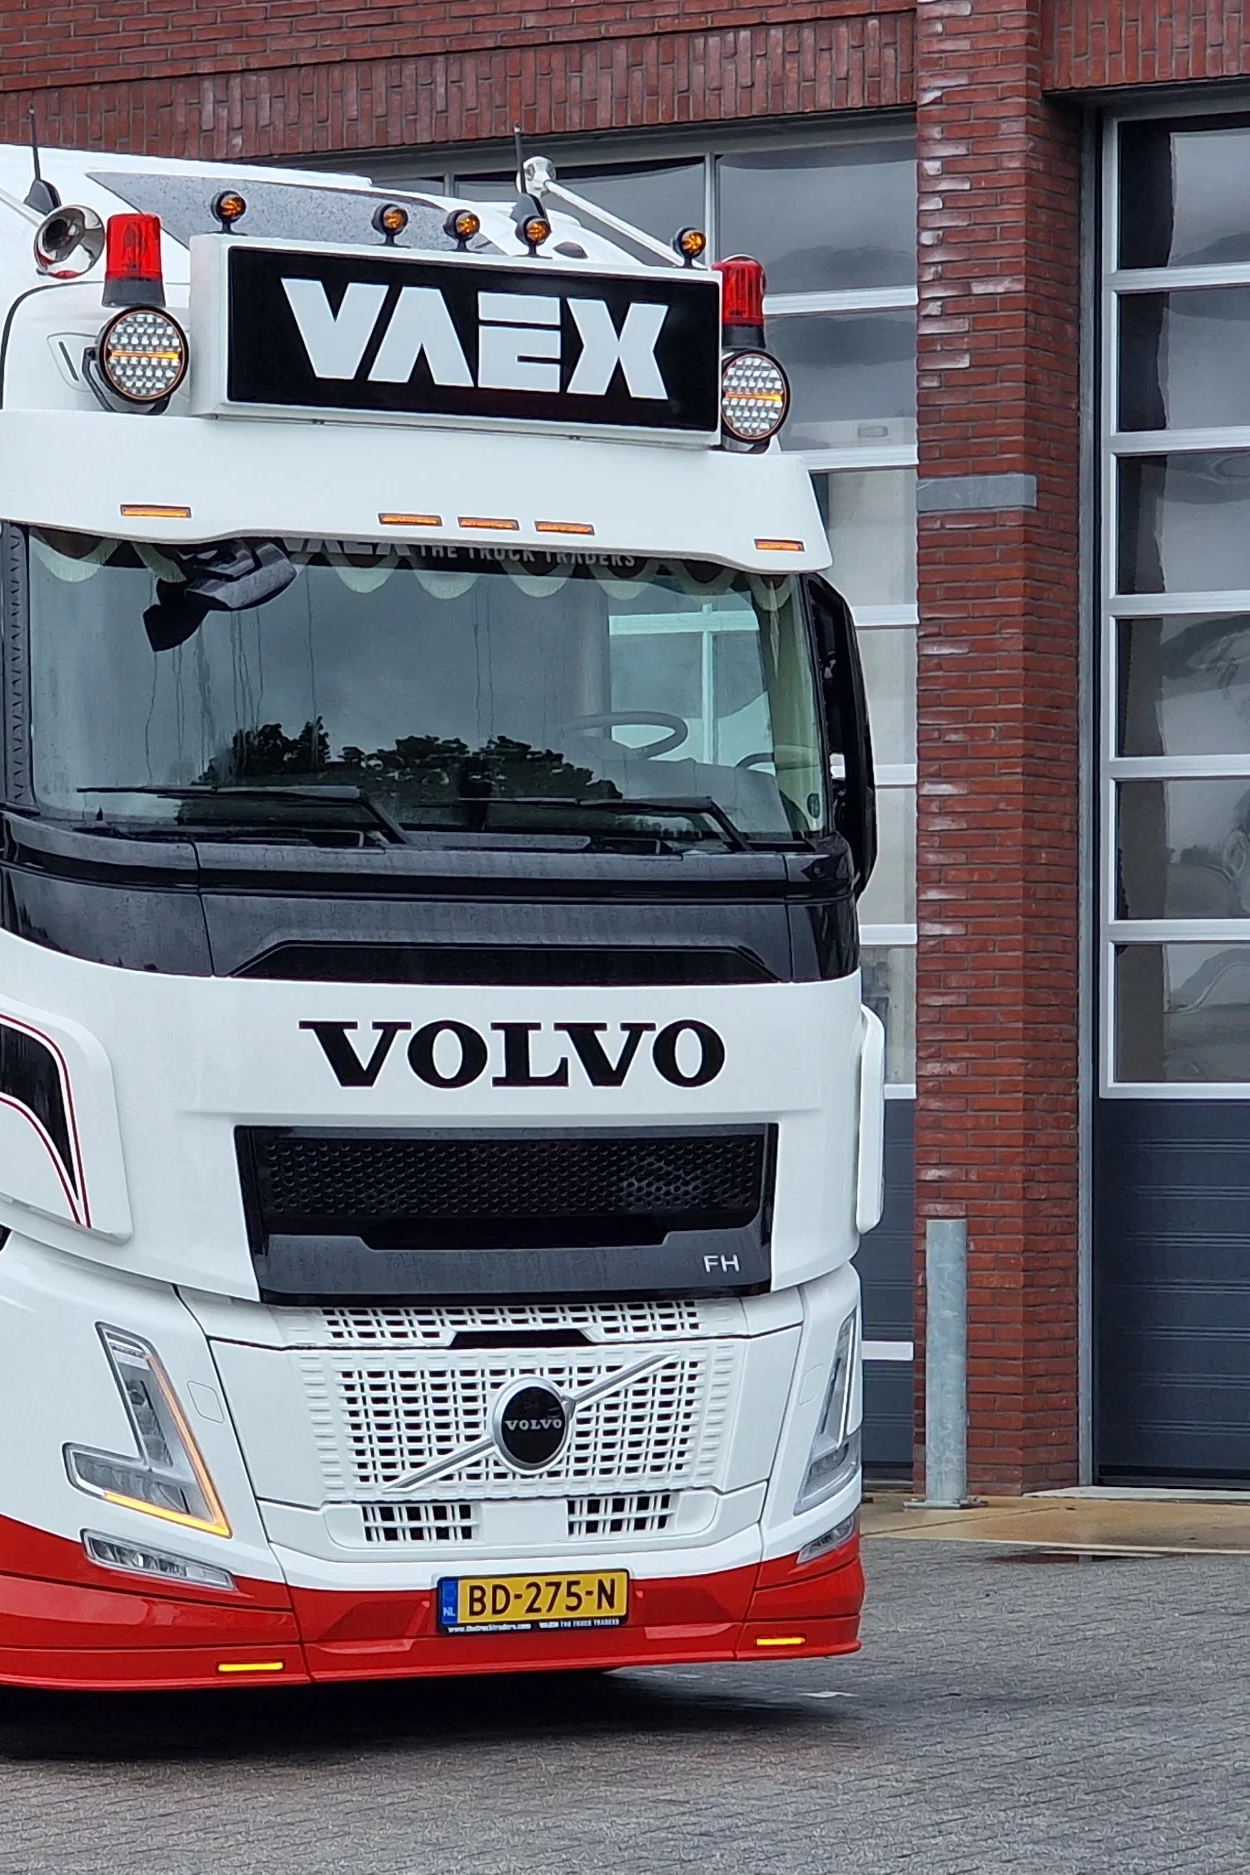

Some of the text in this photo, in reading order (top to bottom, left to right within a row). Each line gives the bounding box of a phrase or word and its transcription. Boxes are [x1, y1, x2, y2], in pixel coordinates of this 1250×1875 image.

[281, 277, 669, 400] VAEX
[420, 545, 458, 558] THE
[469, 547, 536, 562] TRUCK
[545, 551, 635, 567] TRADERS
[299, 1020, 726, 1088] VOLVO
[703, 1254, 740, 1273] FH
[504, 1419, 563, 1431] VOLVO
[468, 1578, 616, 1617] BD-275-N
[442, 1606, 457, 1617] NL
